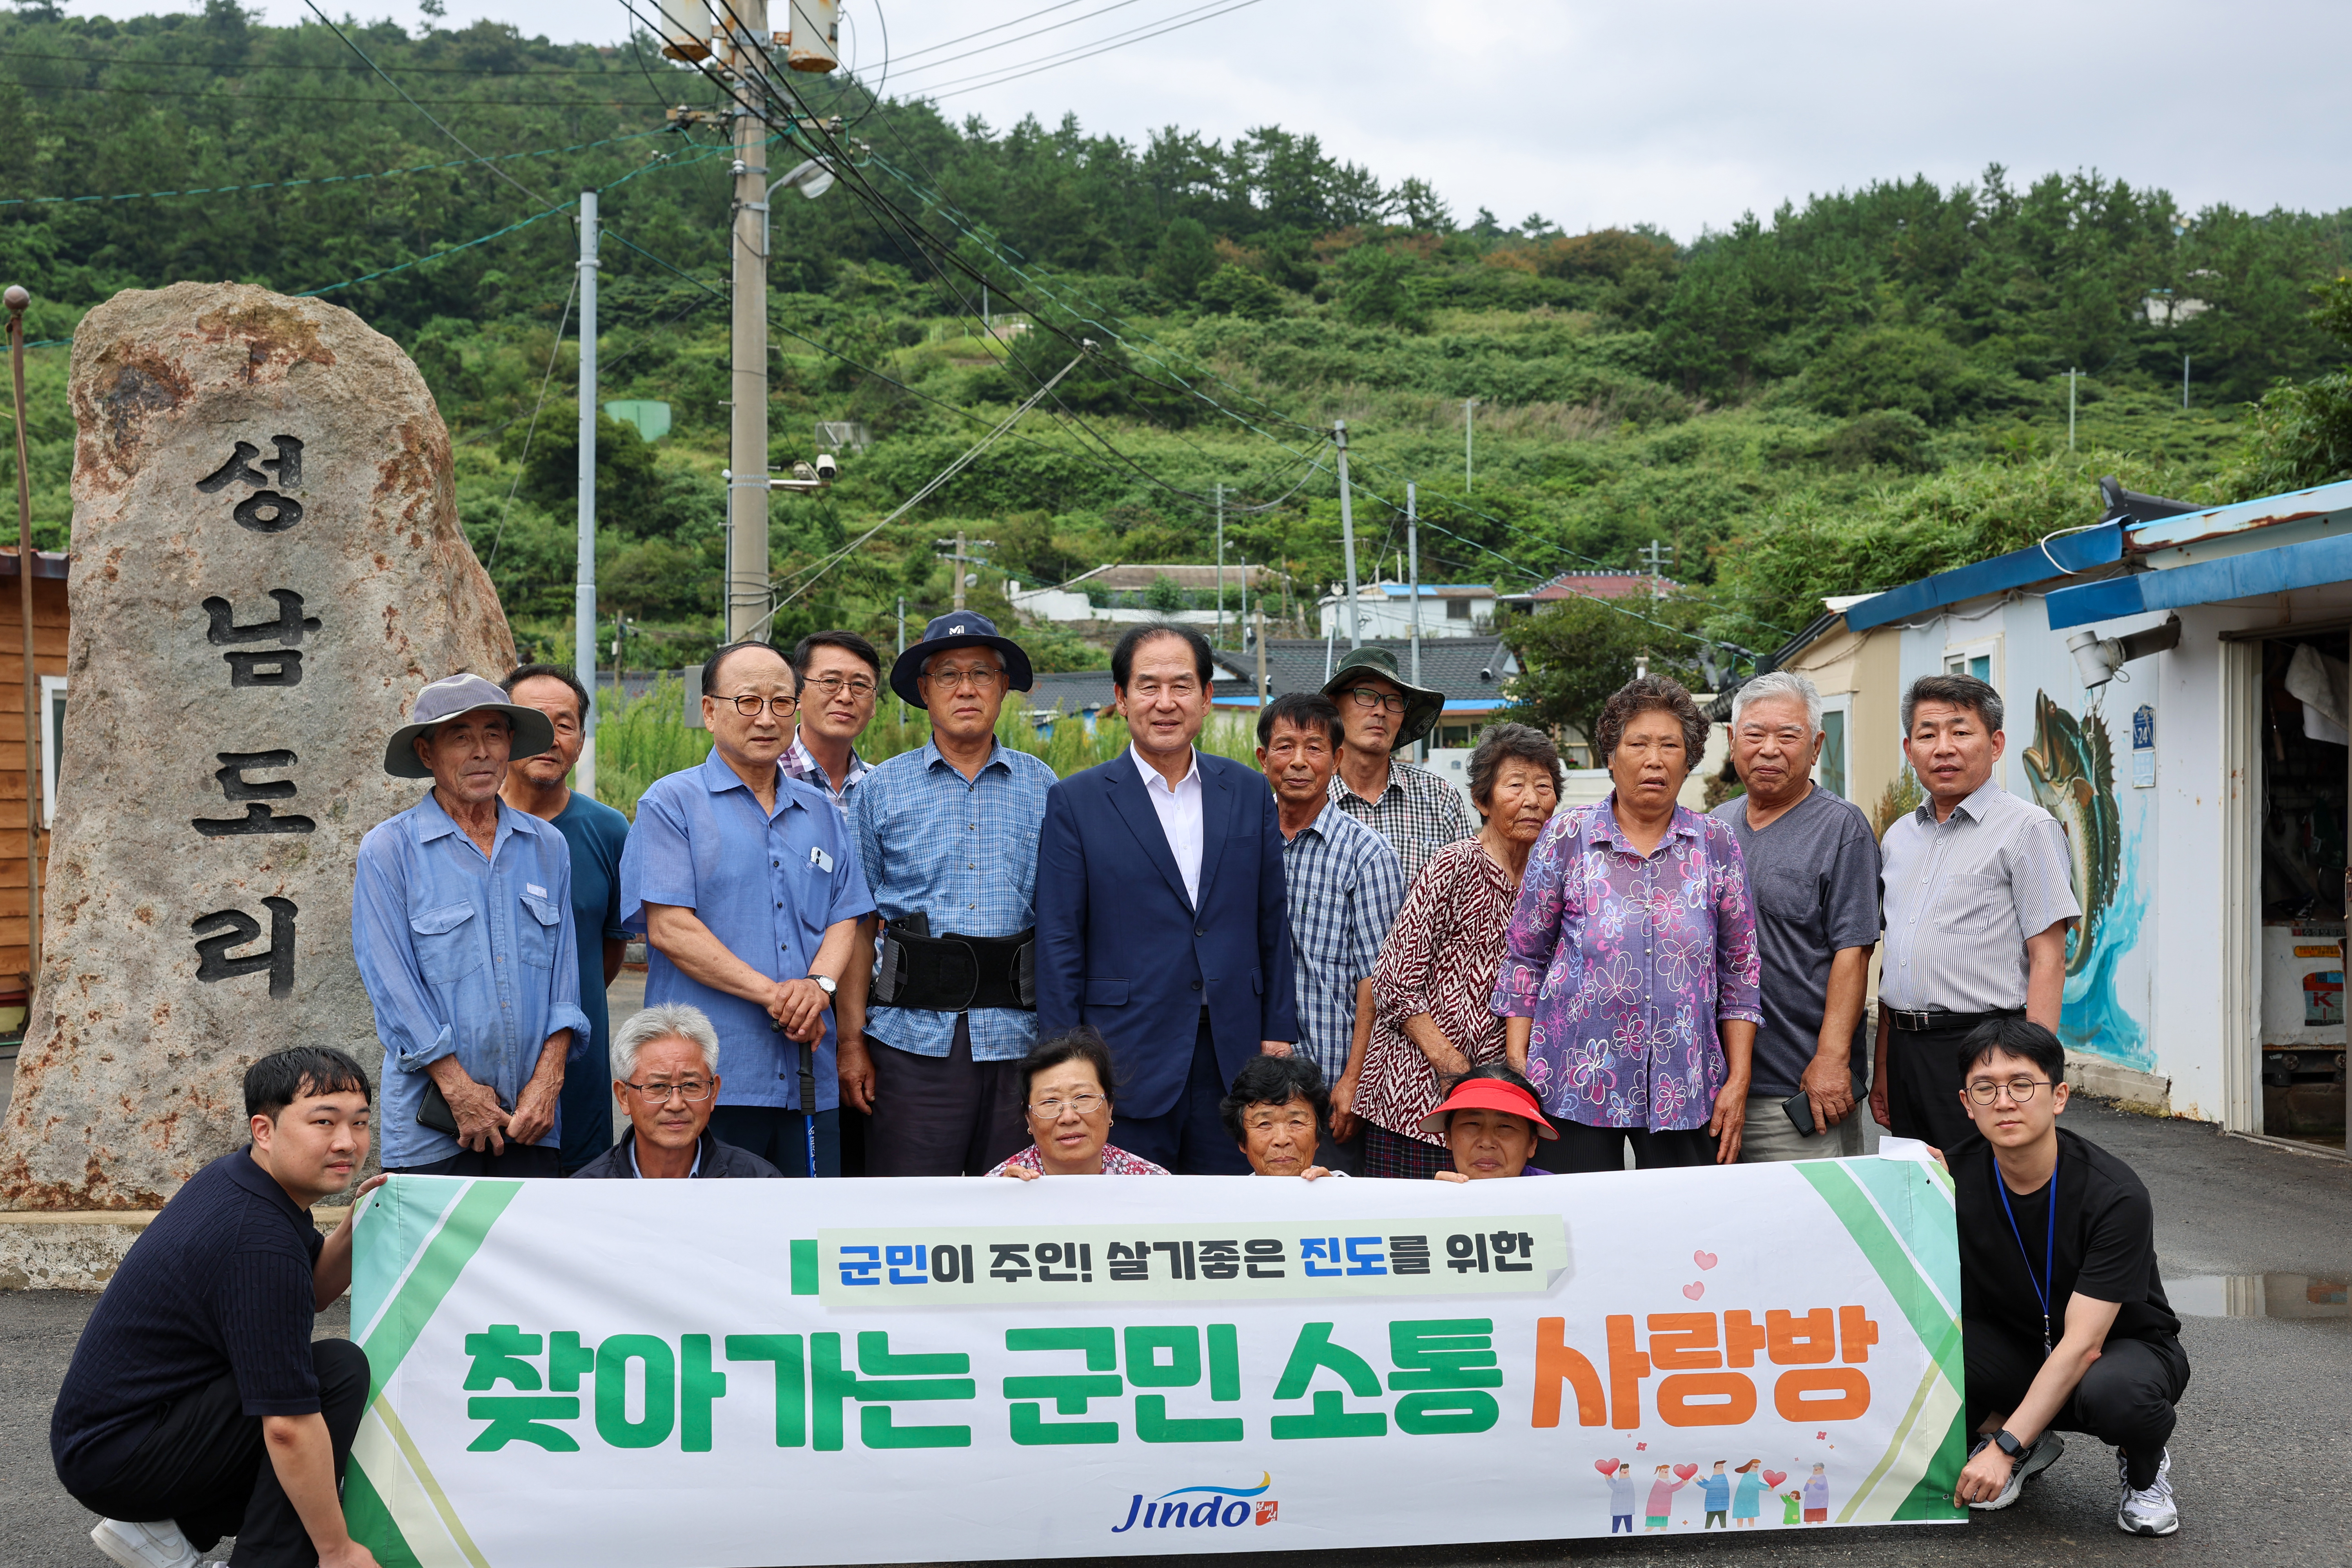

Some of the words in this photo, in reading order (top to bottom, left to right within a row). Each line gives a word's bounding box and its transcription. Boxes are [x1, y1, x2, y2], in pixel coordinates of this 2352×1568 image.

[192, 435, 322, 1000] 성남도리
[2138, 726, 2148, 744] 24
[839, 1245, 974, 1286] 군민이
[990, 1242, 1093, 1283] 주인!
[1107, 1239, 1285, 1281] 살기좋은
[1299, 1235, 1430, 1277] 진도를
[1446, 1230, 1534, 1274] 위한
[463, 1324, 976, 1452] 찾아가는
[1003, 1324, 1243, 1445] 군민
[1271, 1318, 1503, 1439] 소통
[1532, 1305, 1878, 1430] 사랑방
[1112, 1494, 1250, 1532] Jindo
